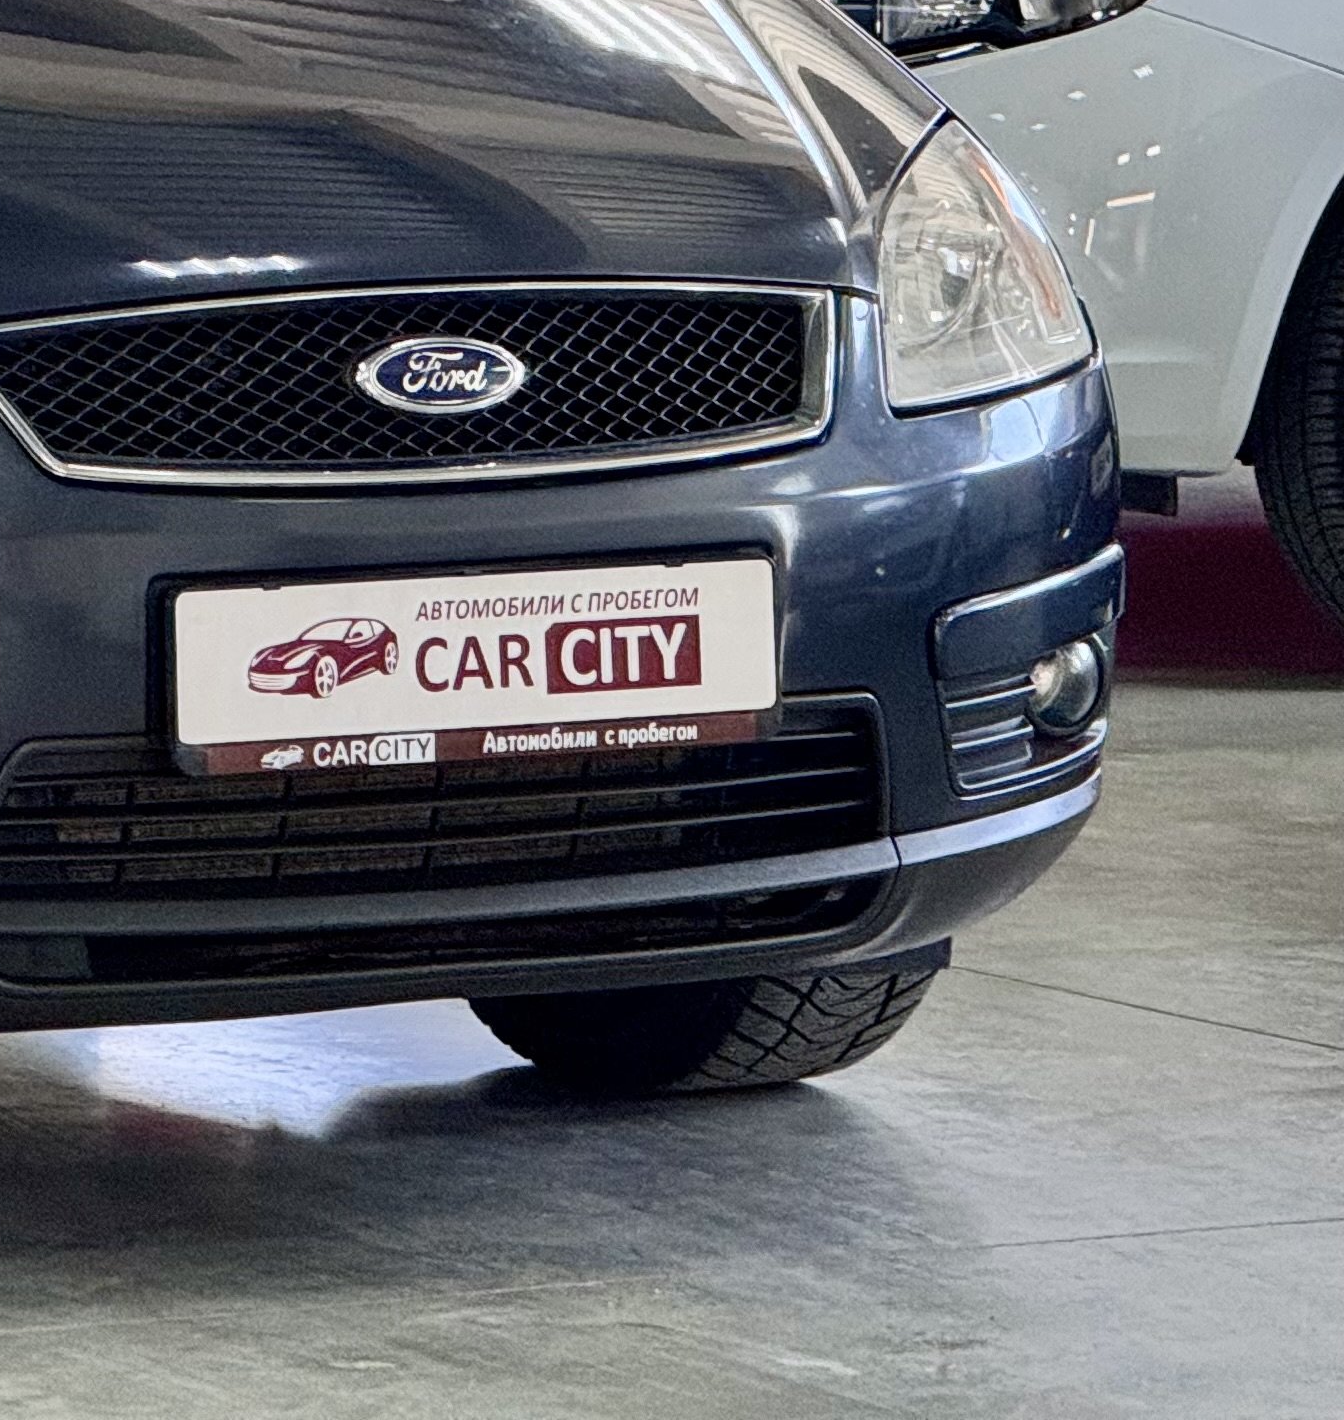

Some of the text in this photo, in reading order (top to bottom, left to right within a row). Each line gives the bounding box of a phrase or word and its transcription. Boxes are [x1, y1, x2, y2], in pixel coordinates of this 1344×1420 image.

[402, 352, 488, 392] Ford
[415, 587, 699, 621] АВТОМОБИЛИ С ПРОБЕГОМ
[415, 622, 688, 692] CAR CITY
[483, 722, 698, 754] Автомобили с пробегом
